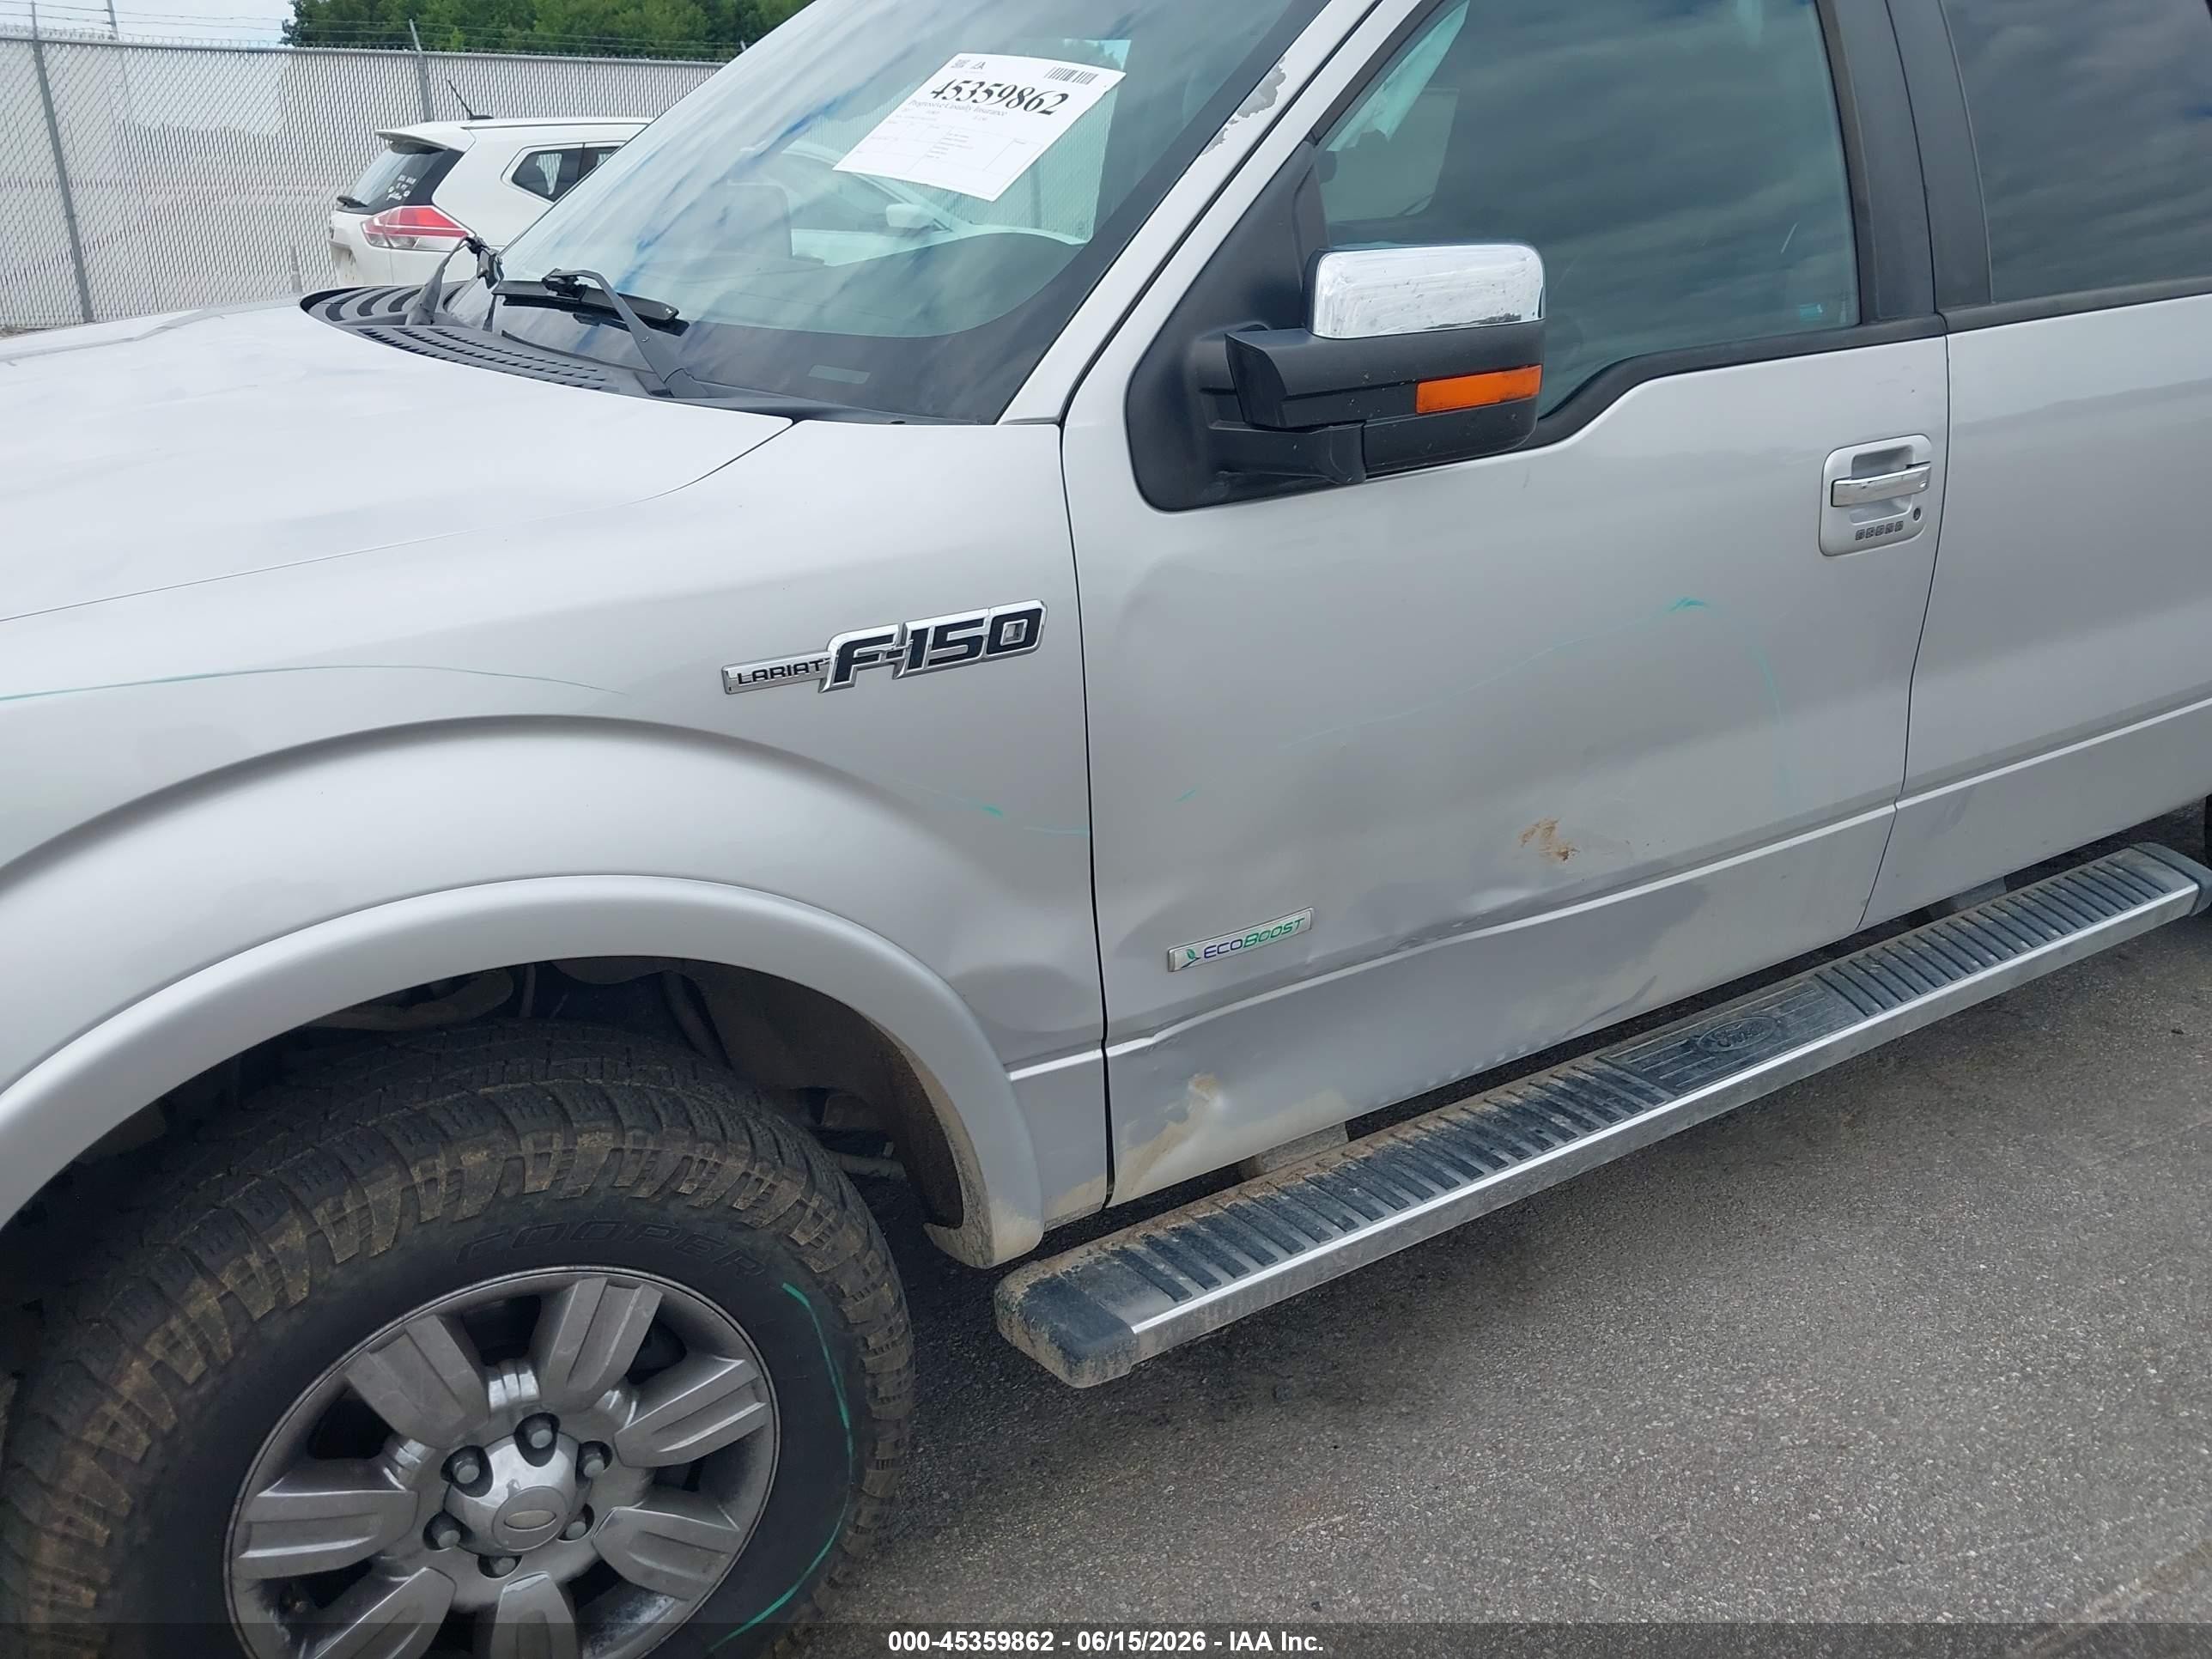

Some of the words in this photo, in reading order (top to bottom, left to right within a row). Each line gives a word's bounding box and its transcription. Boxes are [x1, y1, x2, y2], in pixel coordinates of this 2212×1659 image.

[930, 78, 1069, 116] 45359862
[737, 661, 822, 685] LARIAT
[820, 599, 1048, 692] F-150
[454, 1219, 766, 1279] COOPER
